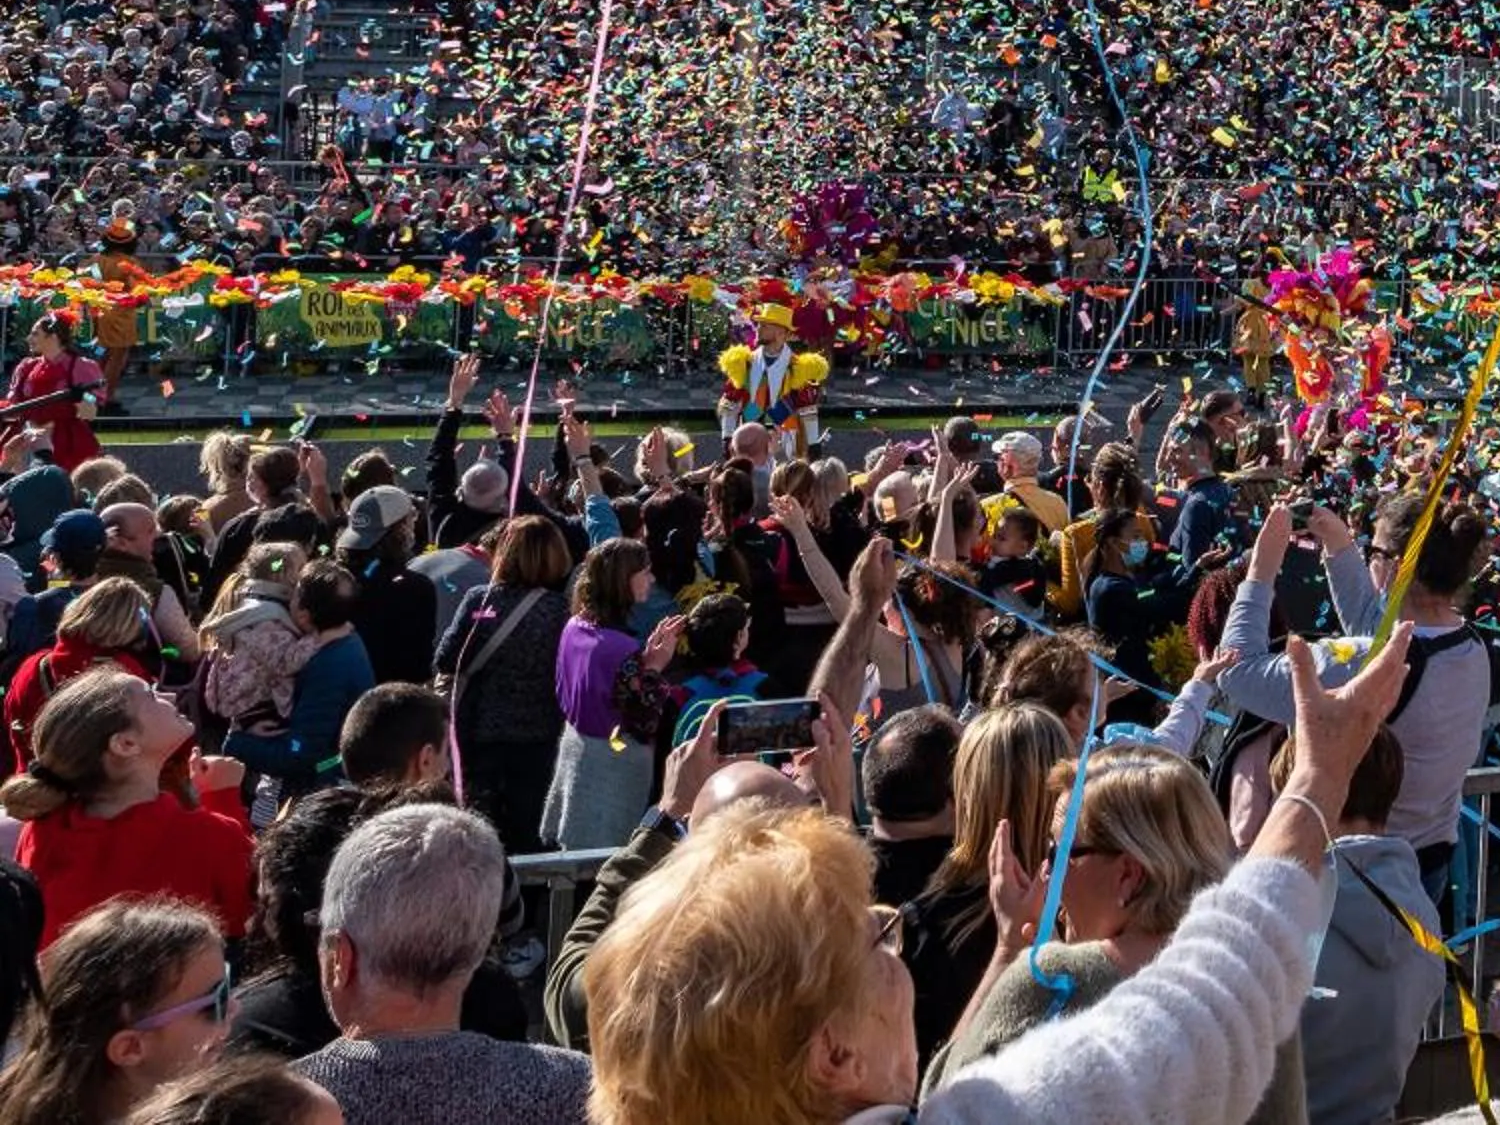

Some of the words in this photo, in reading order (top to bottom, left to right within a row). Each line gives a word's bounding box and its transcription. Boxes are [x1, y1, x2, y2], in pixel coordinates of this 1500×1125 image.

[307, 290, 343, 317] ROI
[315, 319, 379, 338] ANIMAUX
[951, 307, 1010, 348] NICE
